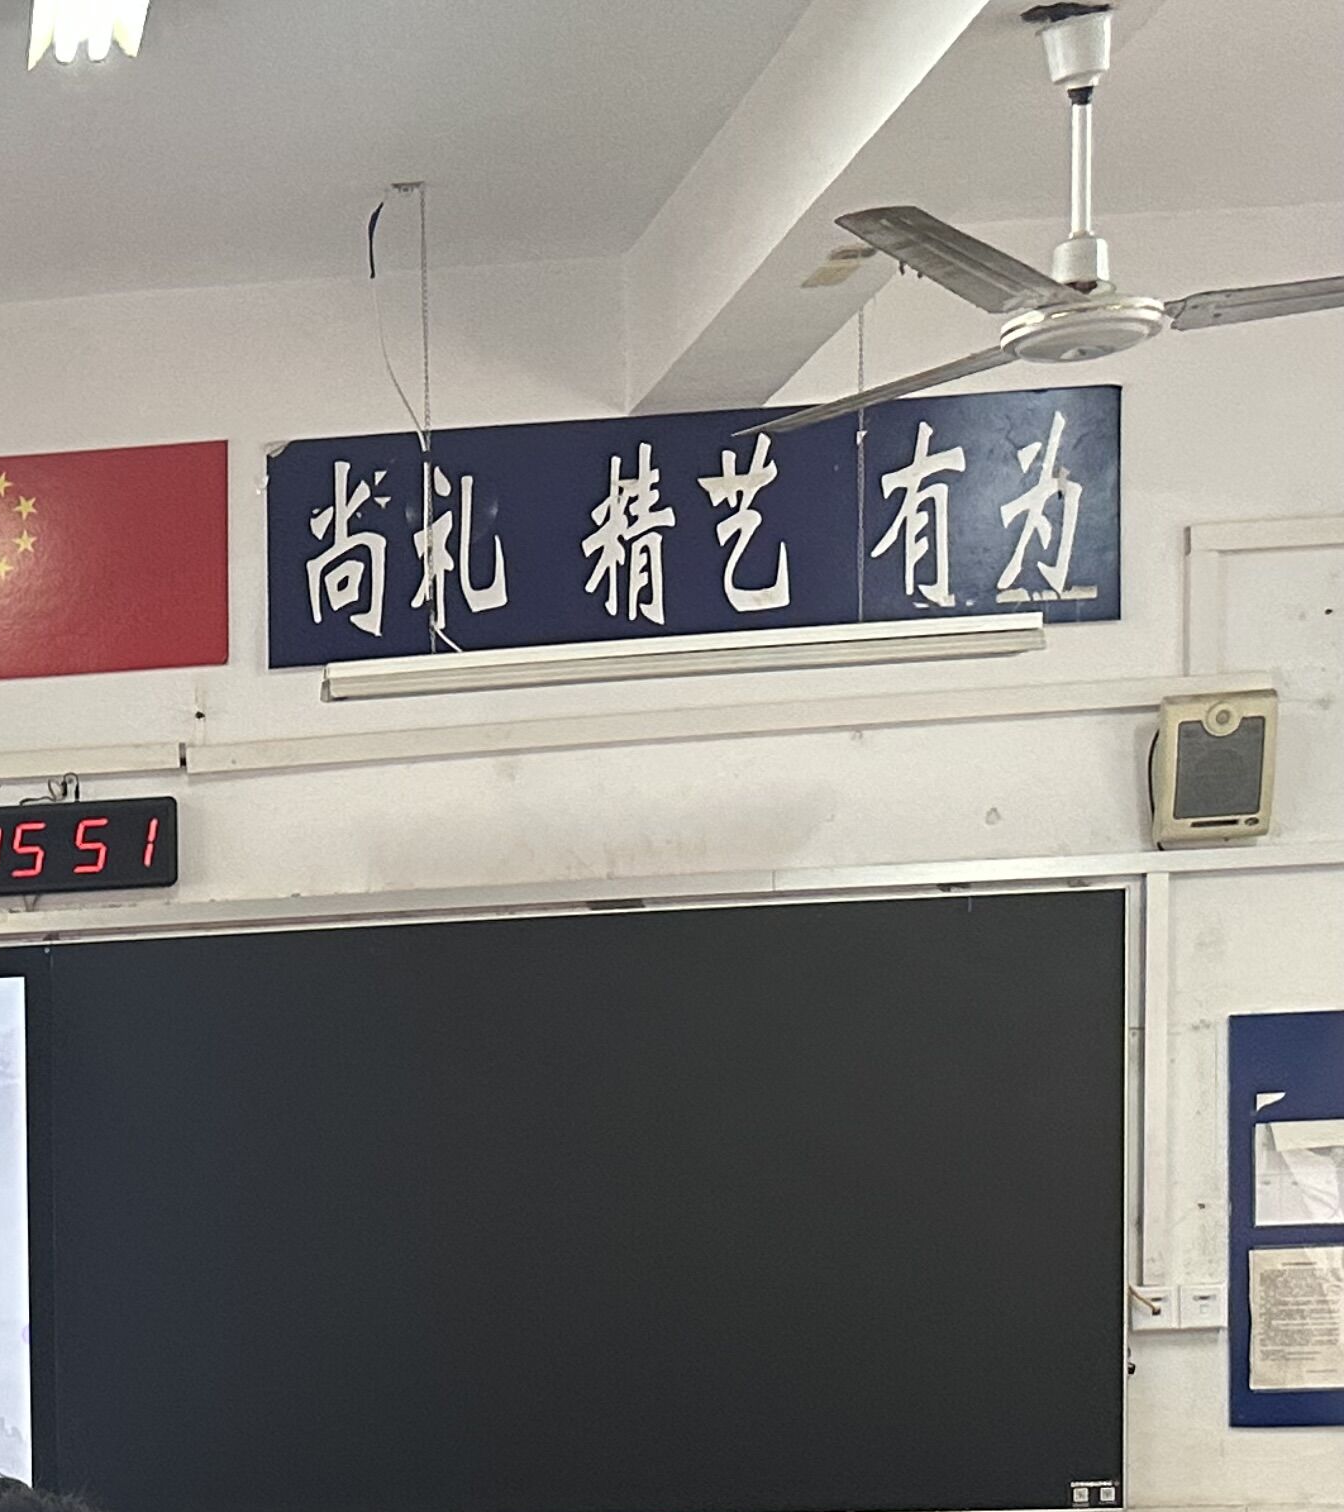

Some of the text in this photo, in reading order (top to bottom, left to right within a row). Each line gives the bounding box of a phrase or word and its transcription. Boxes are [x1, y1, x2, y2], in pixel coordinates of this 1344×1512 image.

[305, 411, 1088, 638] 尚礼 精艺 有为
